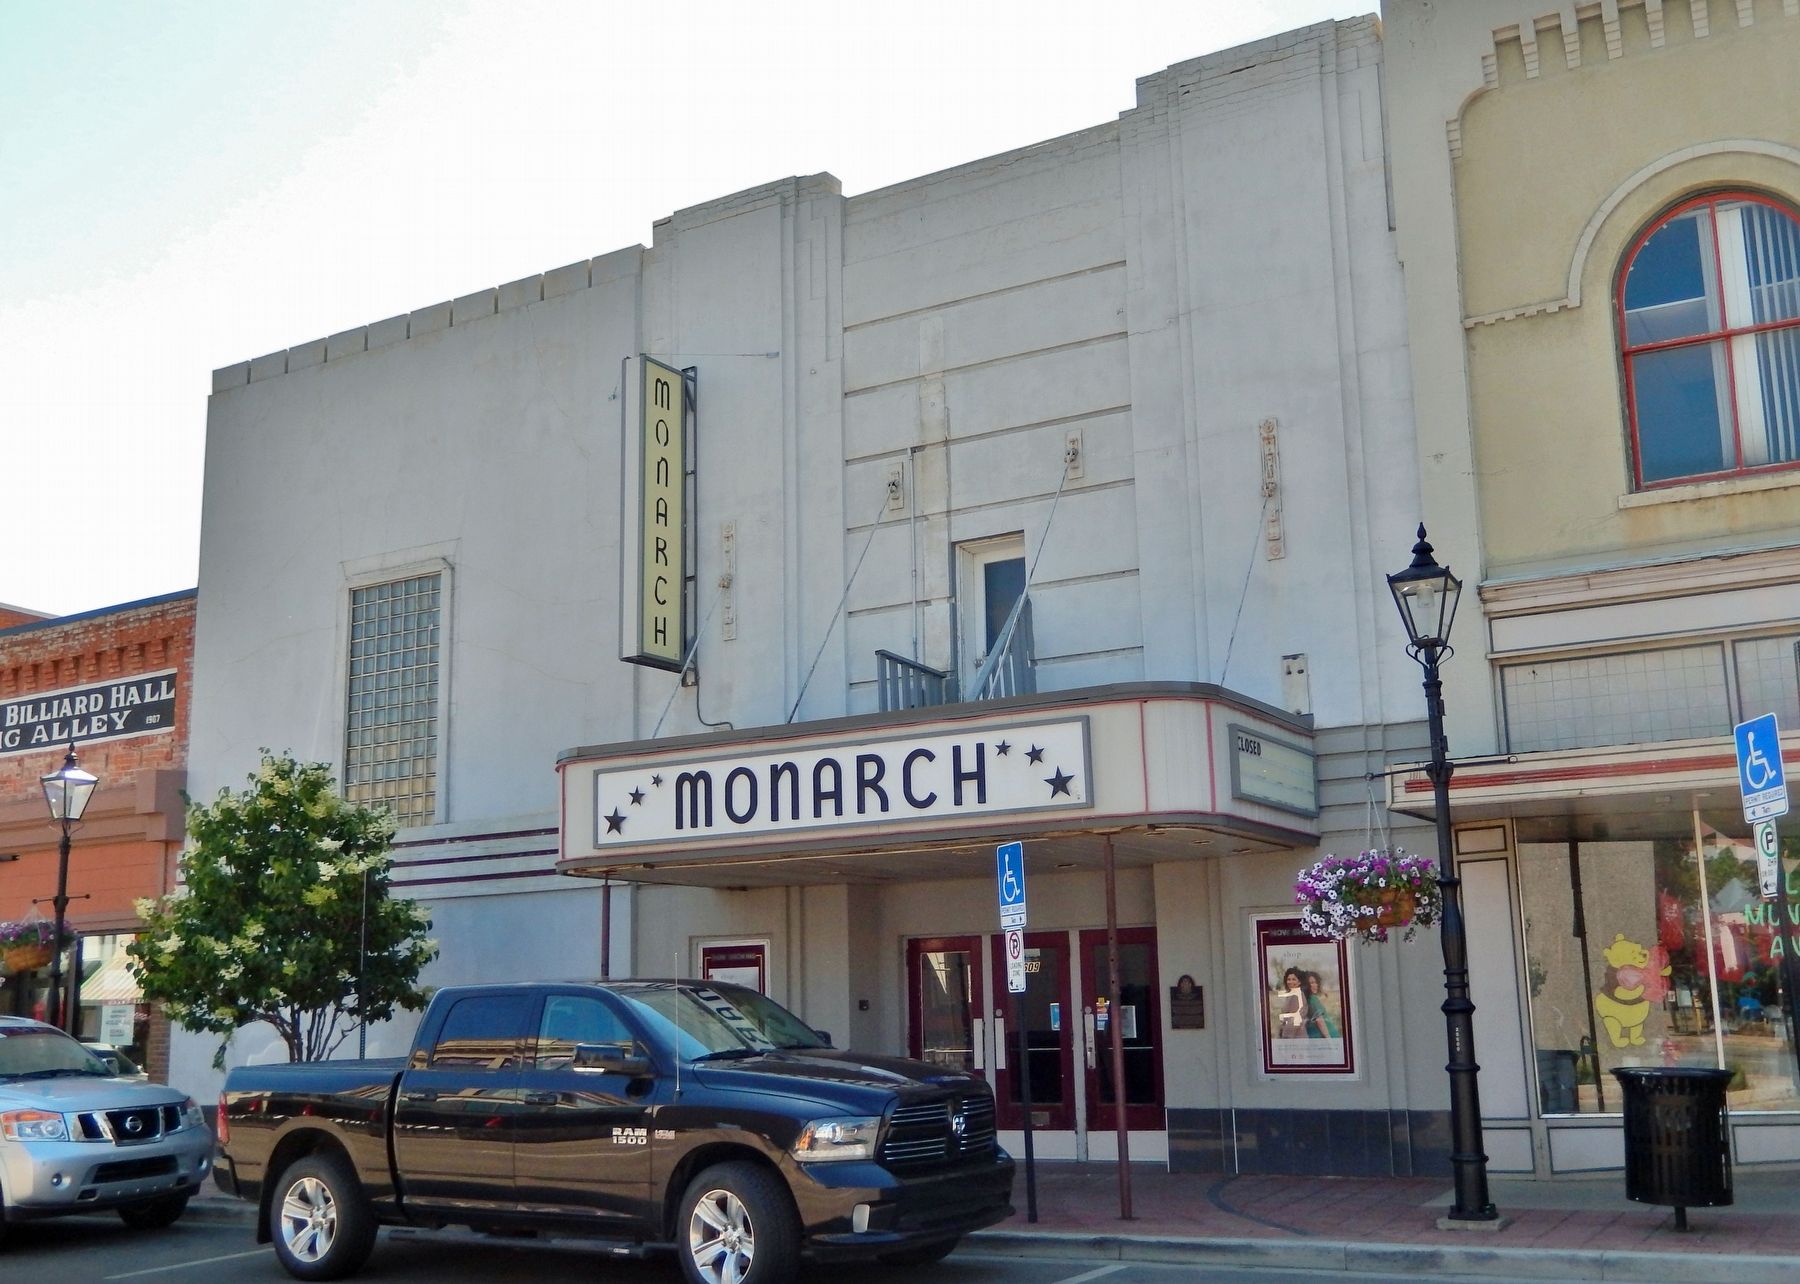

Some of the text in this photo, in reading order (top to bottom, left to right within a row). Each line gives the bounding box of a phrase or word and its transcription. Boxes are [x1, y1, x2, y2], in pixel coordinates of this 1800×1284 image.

[654, 377, 670, 647] MONARCH
[5, 680, 176, 727] BILLIARD HALL
[30, 709, 132, 744] ALLEY
[675, 742, 987, 830] MONARCH
[612, 1127, 648, 1136] RAM
[612, 1135, 648, 1145] 1500
